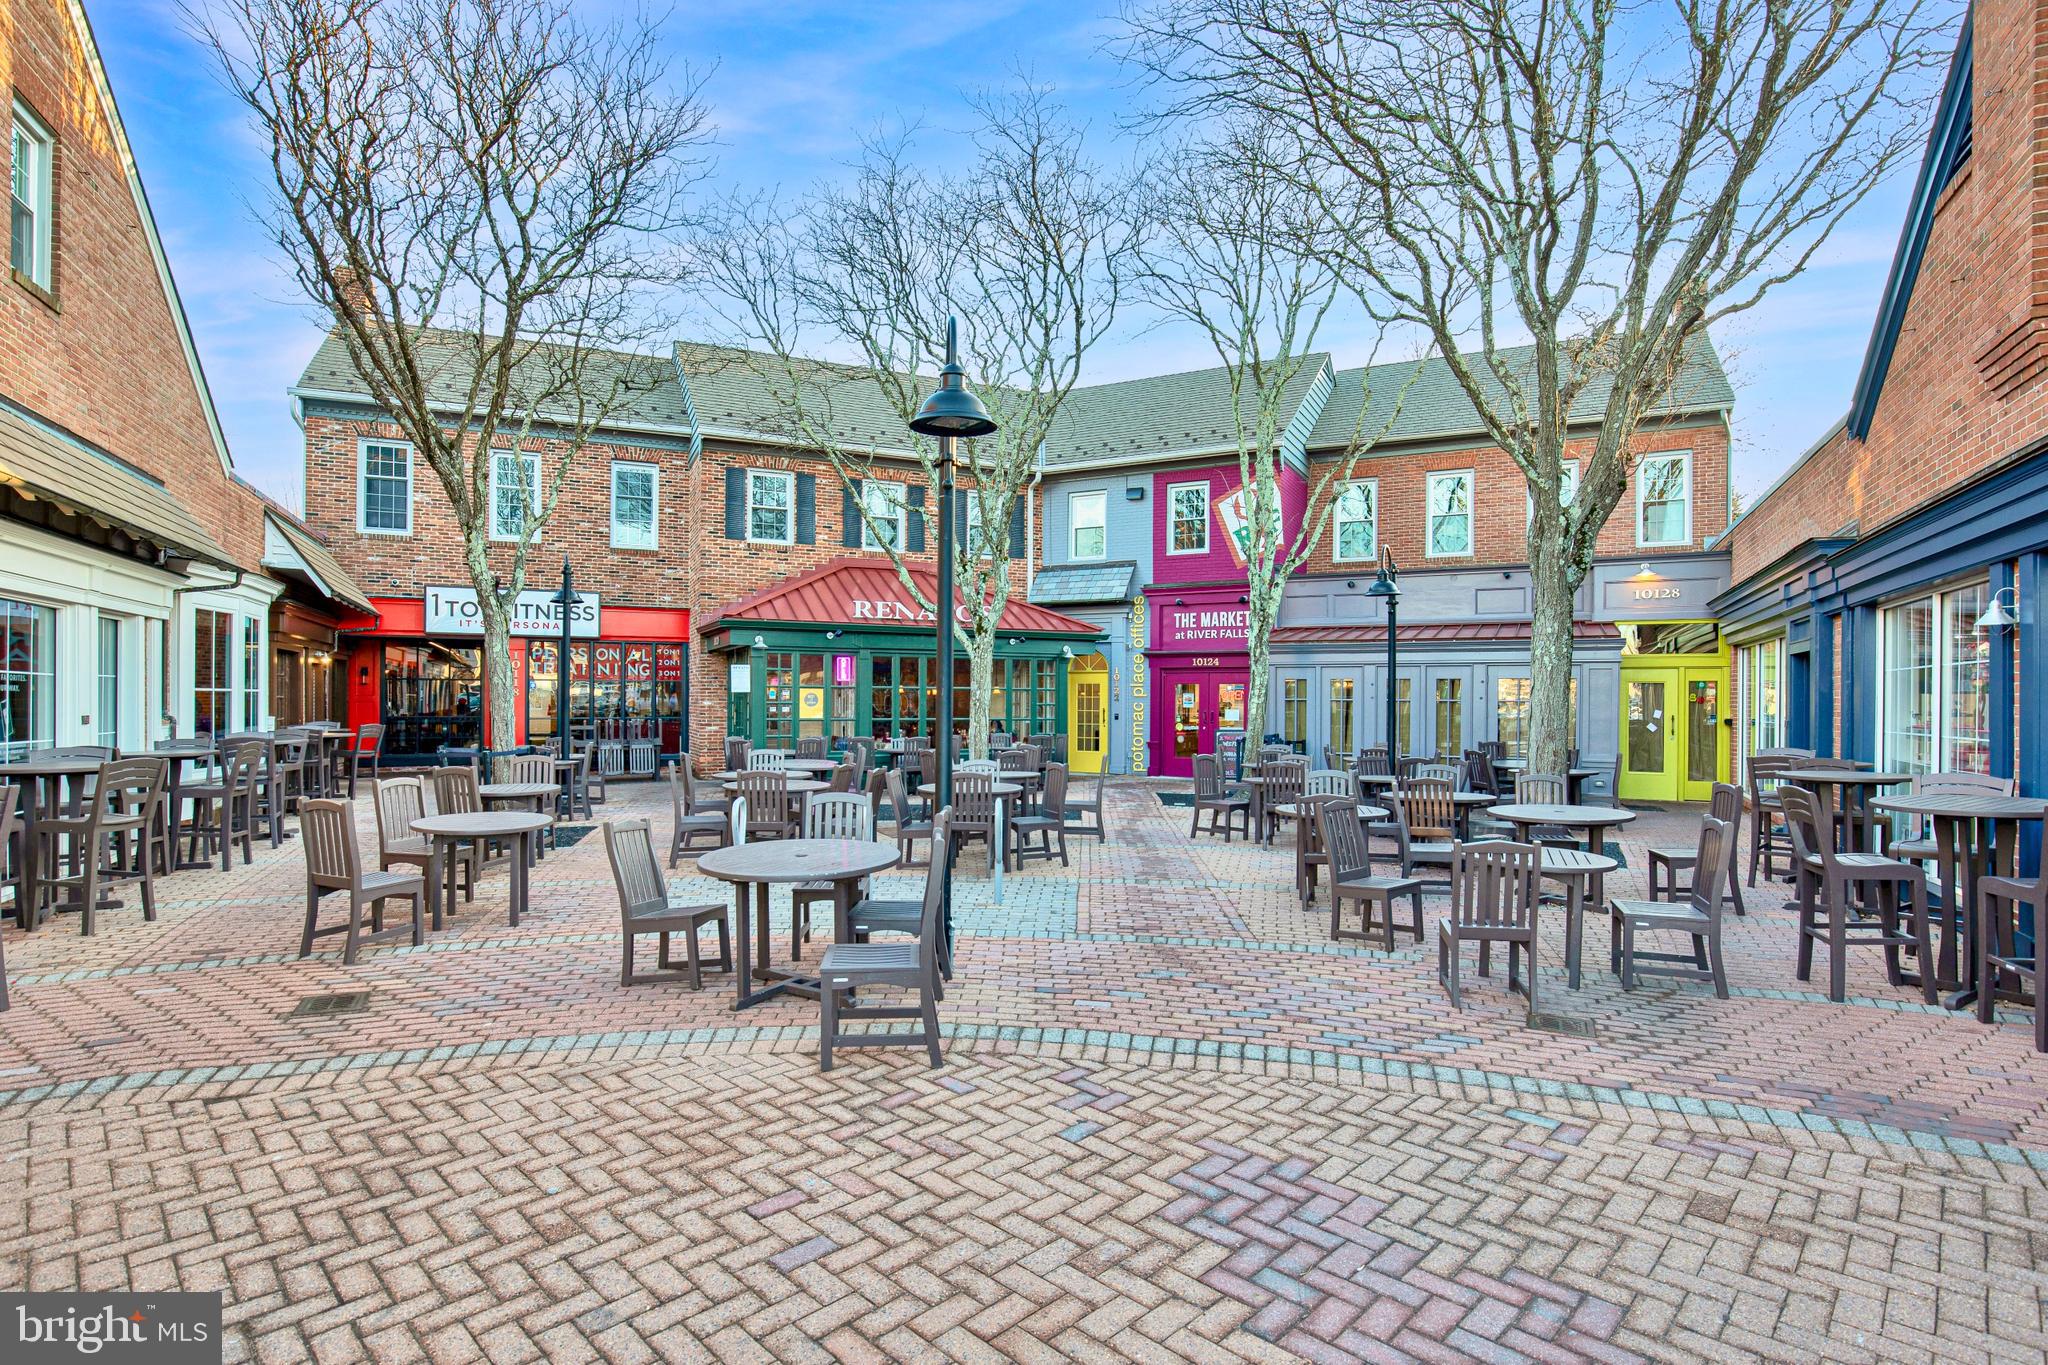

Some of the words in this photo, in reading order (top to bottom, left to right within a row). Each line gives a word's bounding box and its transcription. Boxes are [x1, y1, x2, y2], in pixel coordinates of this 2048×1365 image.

[1633, 588, 1681, 600] 10128
[431, 593, 440, 617] 1
[445, 600, 479, 618] TO
[508, 602, 596, 621] ITNESS
[852, 600, 992, 622] RENAO
[1130, 595, 1145, 648] offices
[1174, 613, 1197, 628] THE
[1200, 611, 1250, 627] MARKET
[1175, 632, 1185, 640] at
[1187, 630, 1217, 639] RIVER
[1220, 629, 1249, 638] FALLS
[1192, 658, 1220, 666] 10124
[1, 673, 28, 682] FAORITES.
[511, 651, 521, 697] 10118
[1130, 653, 1148, 698] place
[1130, 701, 1148, 772] potomac
